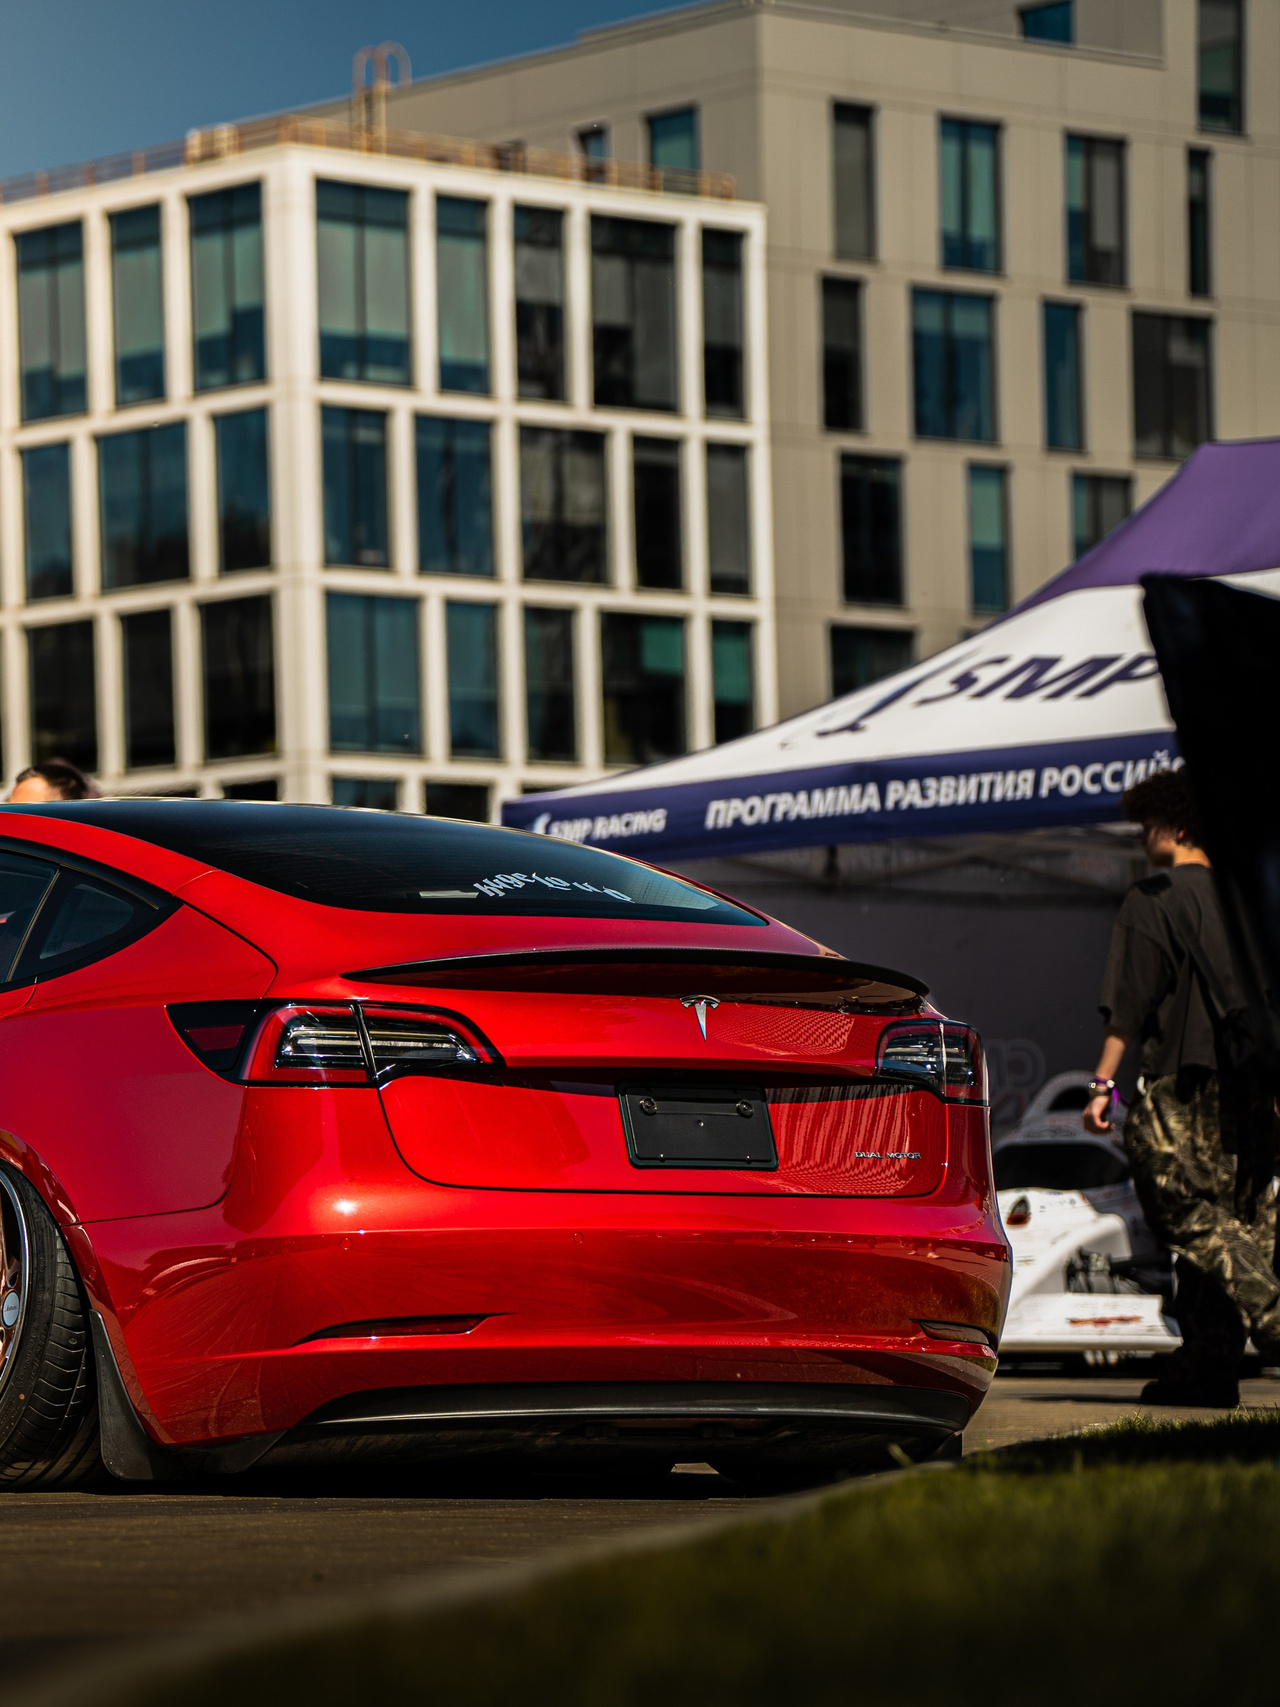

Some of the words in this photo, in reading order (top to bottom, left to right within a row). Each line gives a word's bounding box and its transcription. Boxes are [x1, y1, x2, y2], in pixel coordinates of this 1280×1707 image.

[912, 653, 1158, 707] SMP
[705, 782, 881, 830] ПРОГРАММА
[885, 769, 1036, 811] РАЗВИТИЯ
[549, 817, 593, 844] SMP
[591, 808, 668, 840] RACING
[854, 1151, 884, 1159] DUAL
[886, 1152, 922, 1160] MOTOR
